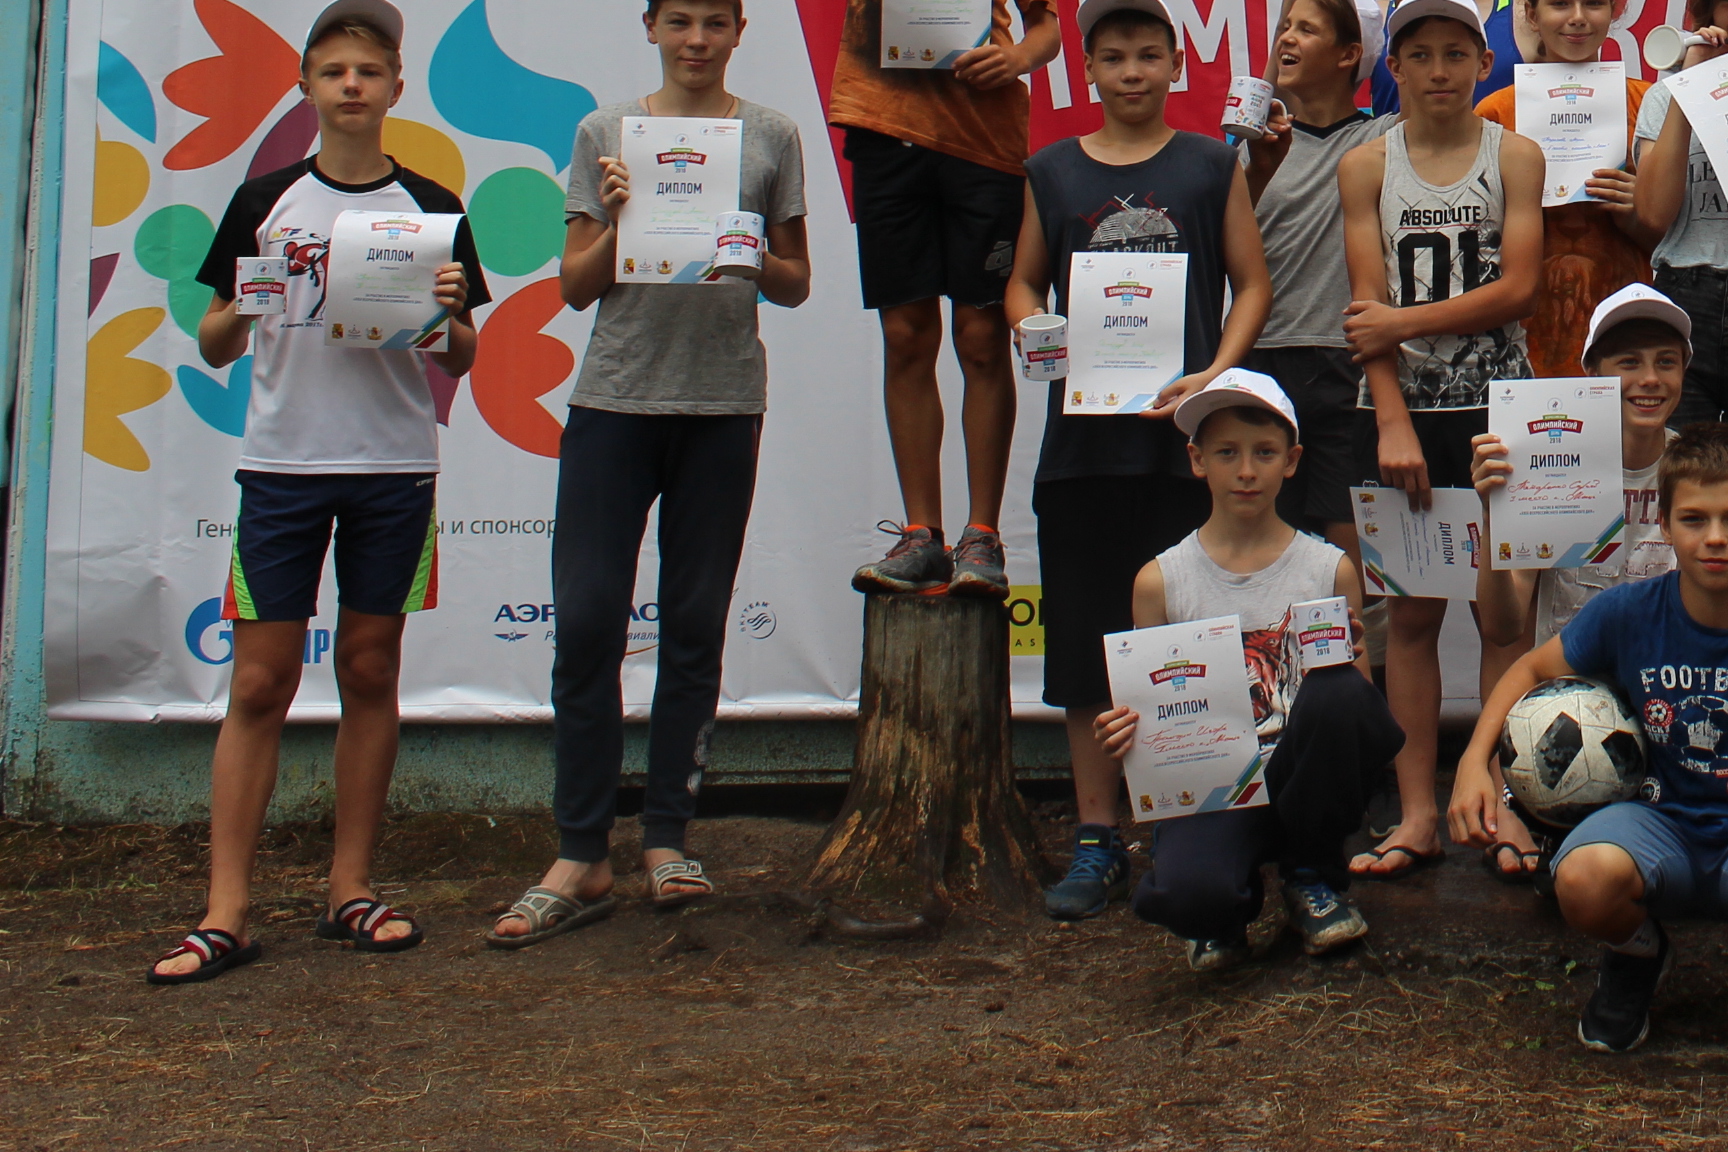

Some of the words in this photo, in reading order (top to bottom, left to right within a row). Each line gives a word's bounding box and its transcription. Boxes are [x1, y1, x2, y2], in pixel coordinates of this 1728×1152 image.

[1550, 113, 1592, 125] ДИПЛОМ
[656, 182, 702, 195] ДИПЛОМ
[1399, 205, 1481, 226] ABSOLUTE
[367, 248, 414, 262] ДИПЛОМ
[1104, 315, 1148, 329] ДИПЛОМ
[1533, 420, 1578, 431] ОЛИМПИЙСКИЙ
[1530, 453, 1580, 470] ДИПЛОМ
[470, 518, 556, 539] спонсор
[1438, 521, 1455, 565] ДИПЛОМ
[1316, 647, 1330, 656] 2018
[1157, 698, 1209, 721] ДИПЛОМ
